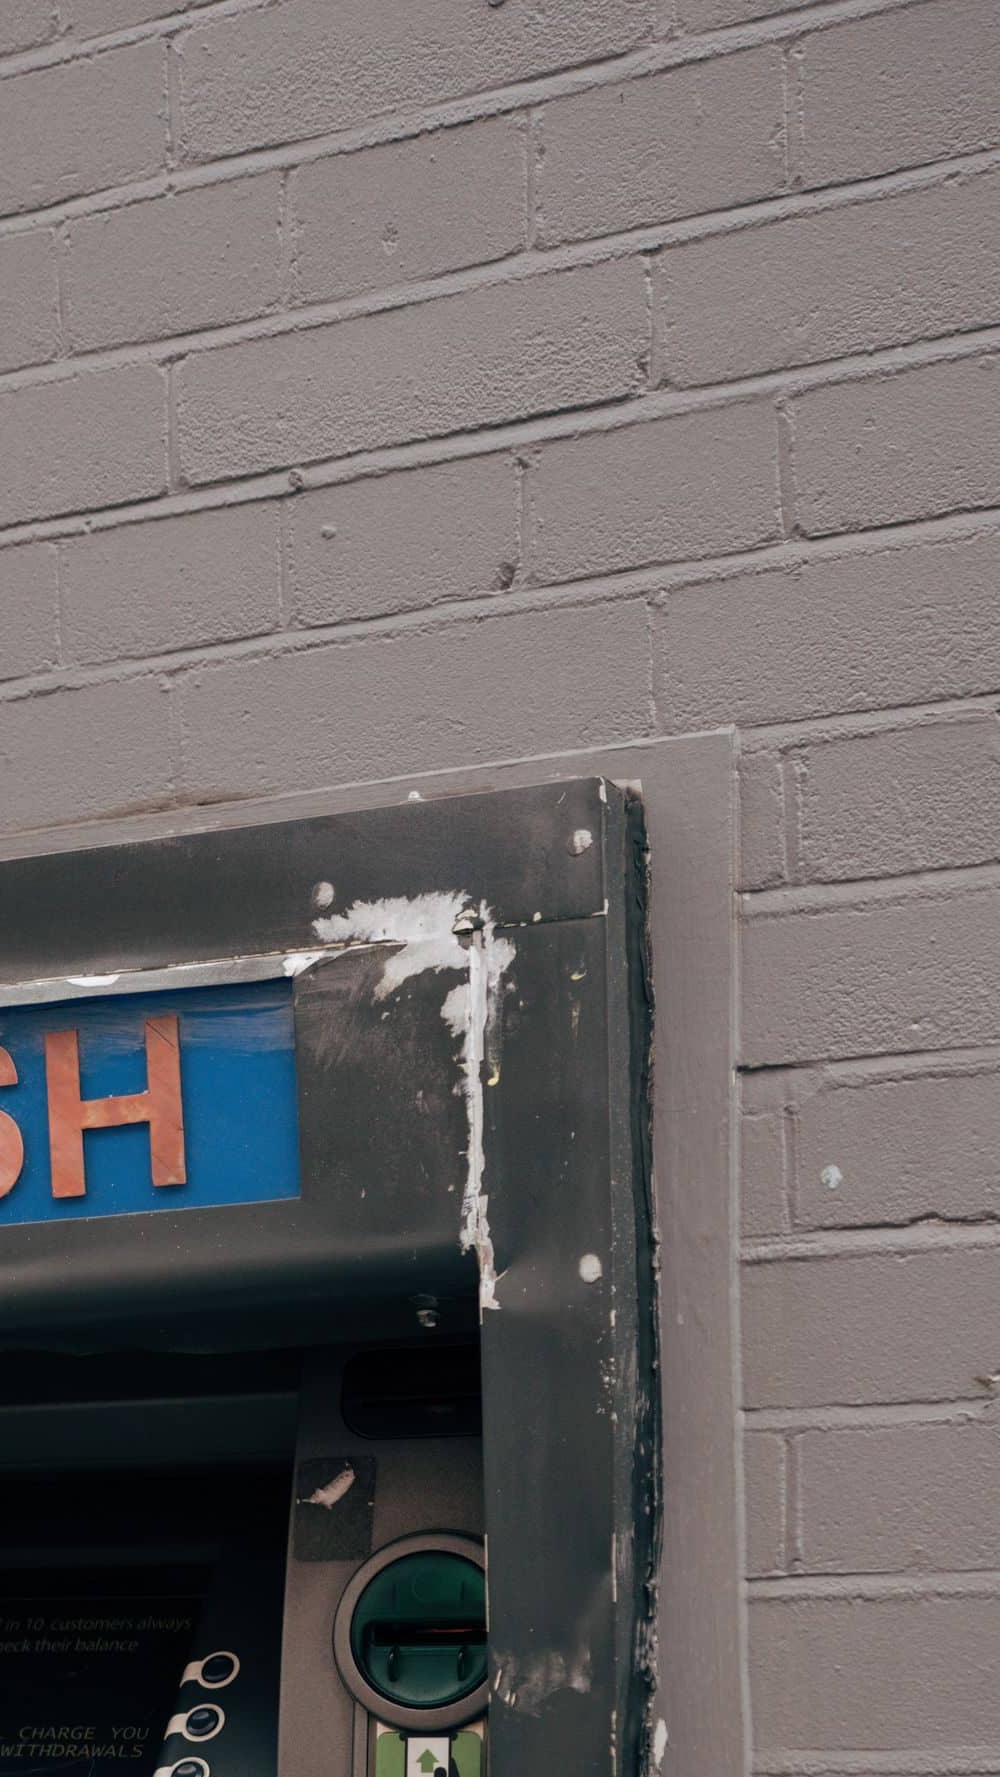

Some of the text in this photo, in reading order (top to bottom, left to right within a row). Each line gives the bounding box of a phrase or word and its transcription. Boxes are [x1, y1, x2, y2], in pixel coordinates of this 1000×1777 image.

[26, 1617, 45, 1631] 10
[50, 1616, 133, 1632] customers
[136, 1615, 192, 1633] always
[33, 1637, 72, 1652] their
[74, 1637, 139, 1652] balance
[19, 1725, 97, 1740] CHARGE
[112, 1725, 150, 1740] YOU
[0, 1743, 145, 1758] WITHDRAWALS
